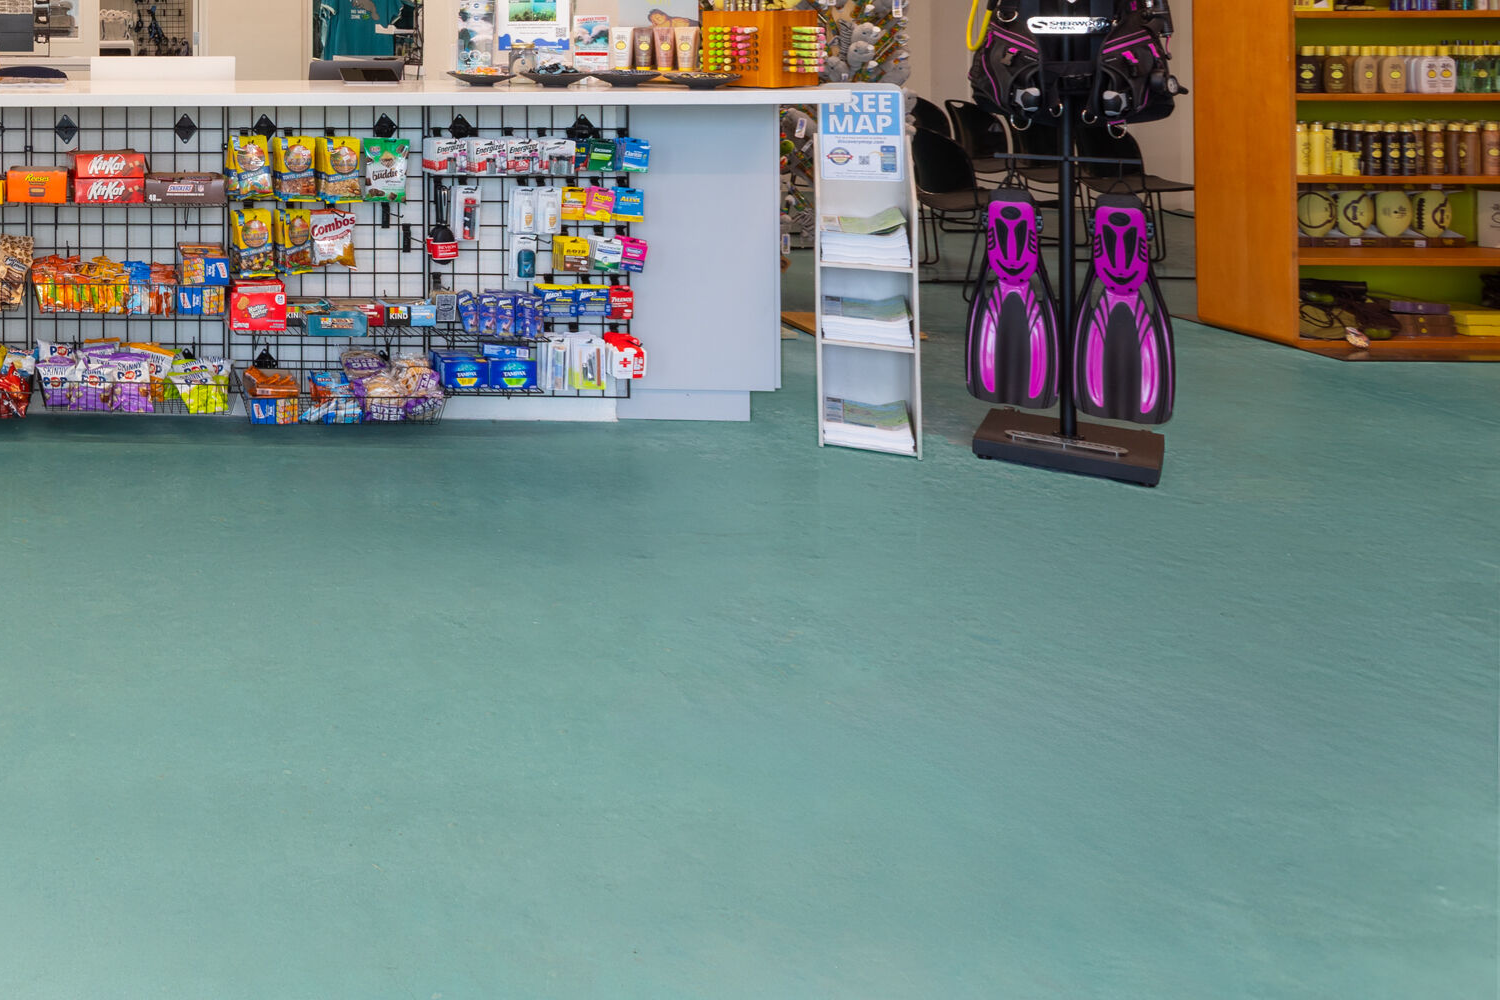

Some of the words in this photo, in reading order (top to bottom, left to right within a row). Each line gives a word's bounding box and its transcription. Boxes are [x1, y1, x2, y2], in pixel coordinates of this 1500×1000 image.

[828, 94, 892, 113] FREE
[828, 114, 893, 133] MAP
[437, 142, 466, 154] Energizer
[476, 143, 505, 154] Energizer
[509, 143, 539, 154] Energizer
[311, 216, 355, 237] Combos
[248, 304, 266, 312] Nutter
[251, 309, 269, 319] Butter
[389, 312, 409, 320] KIND
[50, 347, 74, 357] POP
[43, 366, 67, 376] SKINNY
[118, 361, 142, 371] SKINNY
[81, 375, 106, 386] POP
[117, 370, 142, 380] POP
[43, 376, 68, 388] POP
